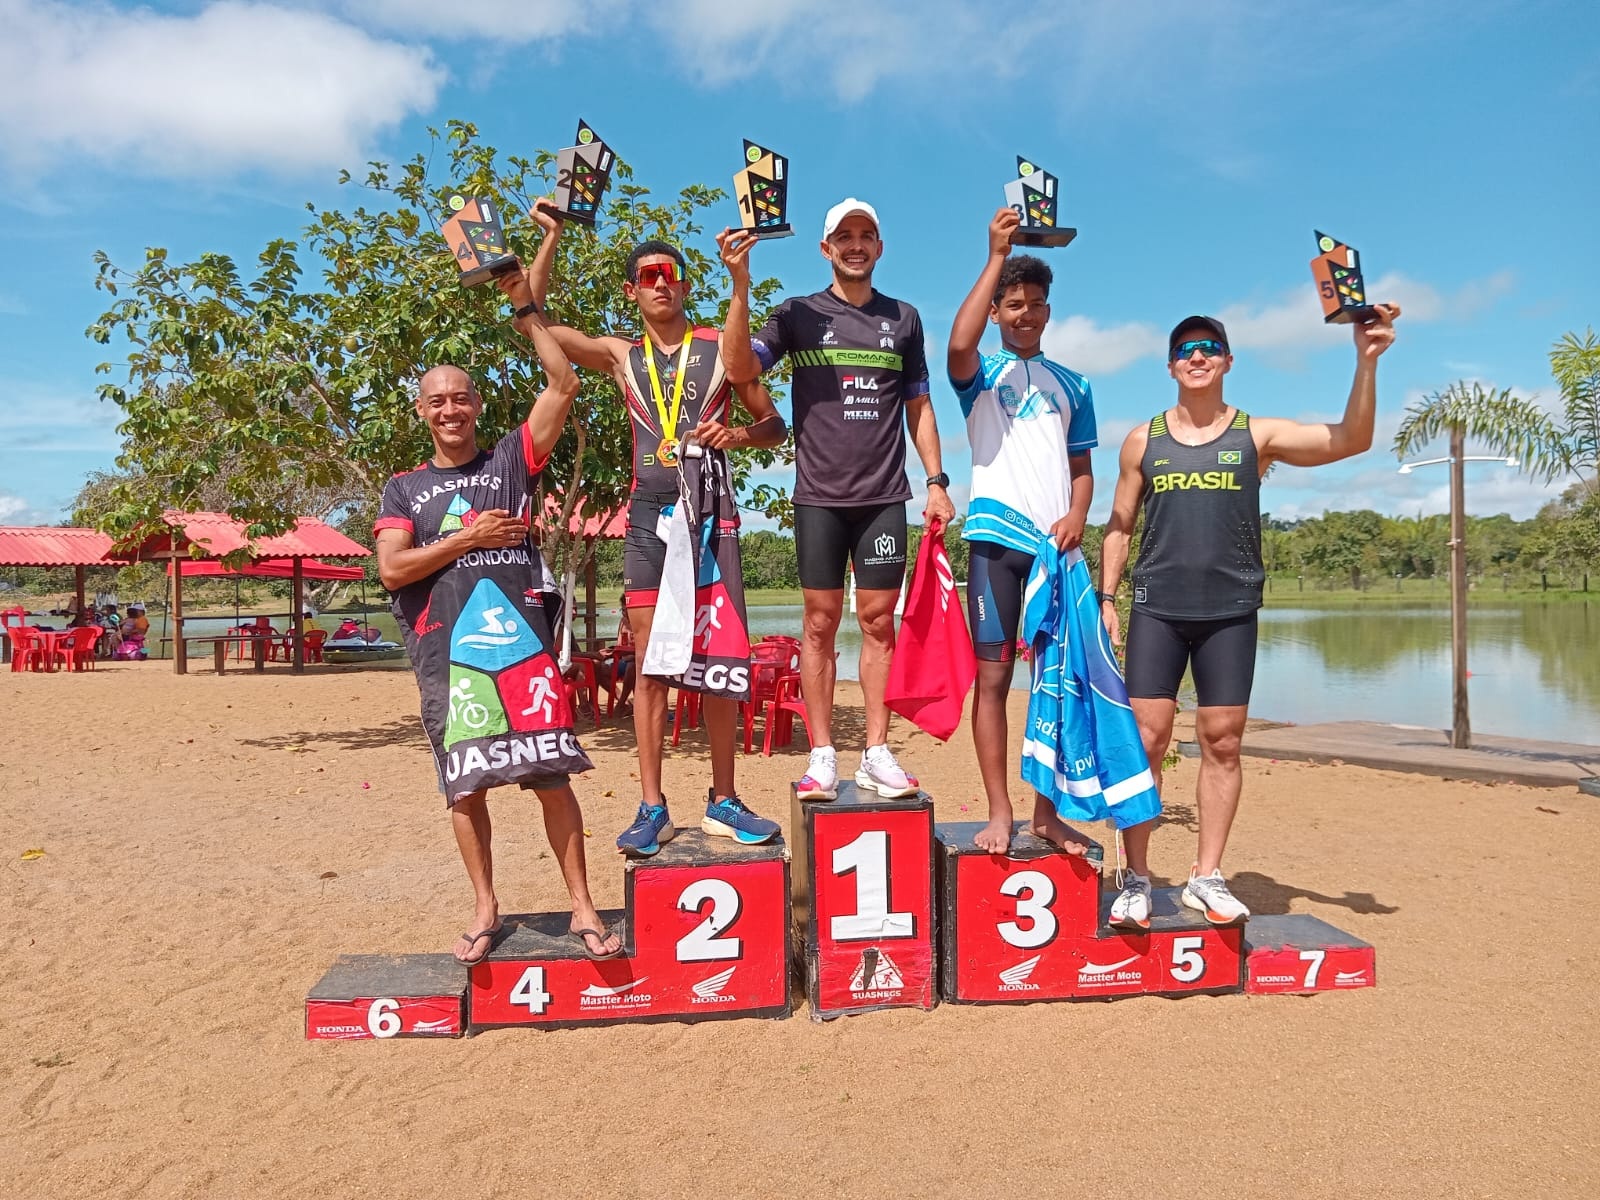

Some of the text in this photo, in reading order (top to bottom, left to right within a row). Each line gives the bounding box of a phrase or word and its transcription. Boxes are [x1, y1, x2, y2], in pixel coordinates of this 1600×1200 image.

[557, 168, 572, 189] 2
[739, 194, 751, 214] 1
[457, 242, 472, 260] 4
[1321, 281, 1334, 299] 5
[836, 352, 896, 363] ROMANO
[842, 375, 878, 390] FILA
[1152, 471, 1242, 494] BRASIL
[411, 474, 502, 514] SUASNEGS
[456, 546, 531, 569] RONDÔNIA
[831, 831, 912, 940] 1
[996, 870, 1056, 948] 3
[676, 878, 741, 962] 2
[1170, 937, 1205, 982] 5
[1299, 950, 1326, 988] 7
[998, 982, 1041, 991] HONDA
[1078, 971, 1142, 983] Mastter Moto
[1256, 975, 1296, 983] HONDA
[510, 966, 550, 1013] 4
[580, 993, 652, 1006] Mastter Moto
[691, 994, 737, 1004] HONDA
[852, 990, 901, 1000] SUASNEGS
[367, 998, 402, 1038] 6
[315, 1025, 365, 1033] HONDA
